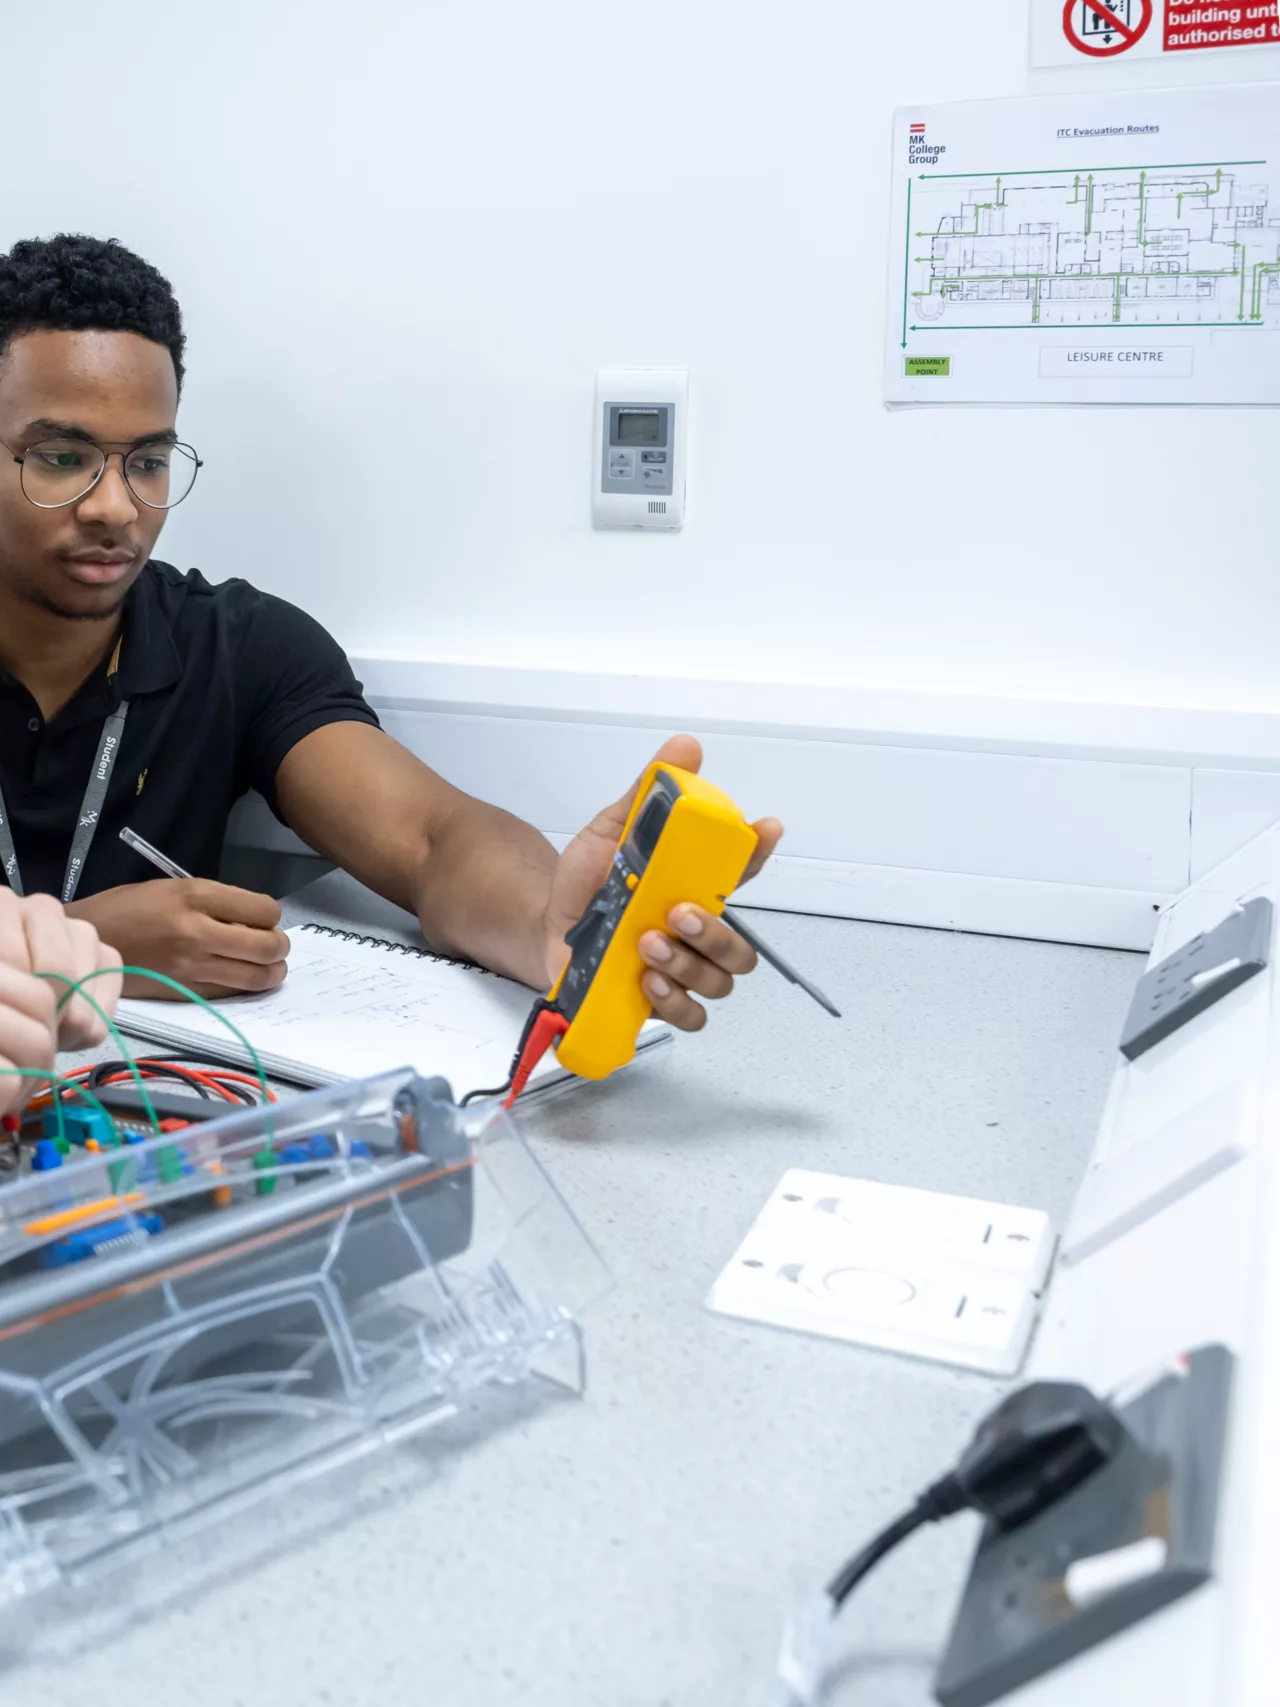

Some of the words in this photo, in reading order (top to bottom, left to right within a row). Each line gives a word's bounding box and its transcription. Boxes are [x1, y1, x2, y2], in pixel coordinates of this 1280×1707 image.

[1168, 8, 1240, 25] building
[1245, 3, 1278, 18] unt
[1168, 23, 1266, 45] authorised
[1057, 128, 1071, 137] ITC
[1073, 126, 1124, 136] Evacuation
[1127, 125, 1160, 133] Routes
[909, 135, 925, 144] MK
[909, 145, 946, 155] College
[908, 155, 939, 165] Group
[1067, 352, 1114, 362] LEISURE
[1117, 352, 1164, 362] CENTRE
[96, 736, 116, 780] Student
[63, 857, 81, 902] Student
